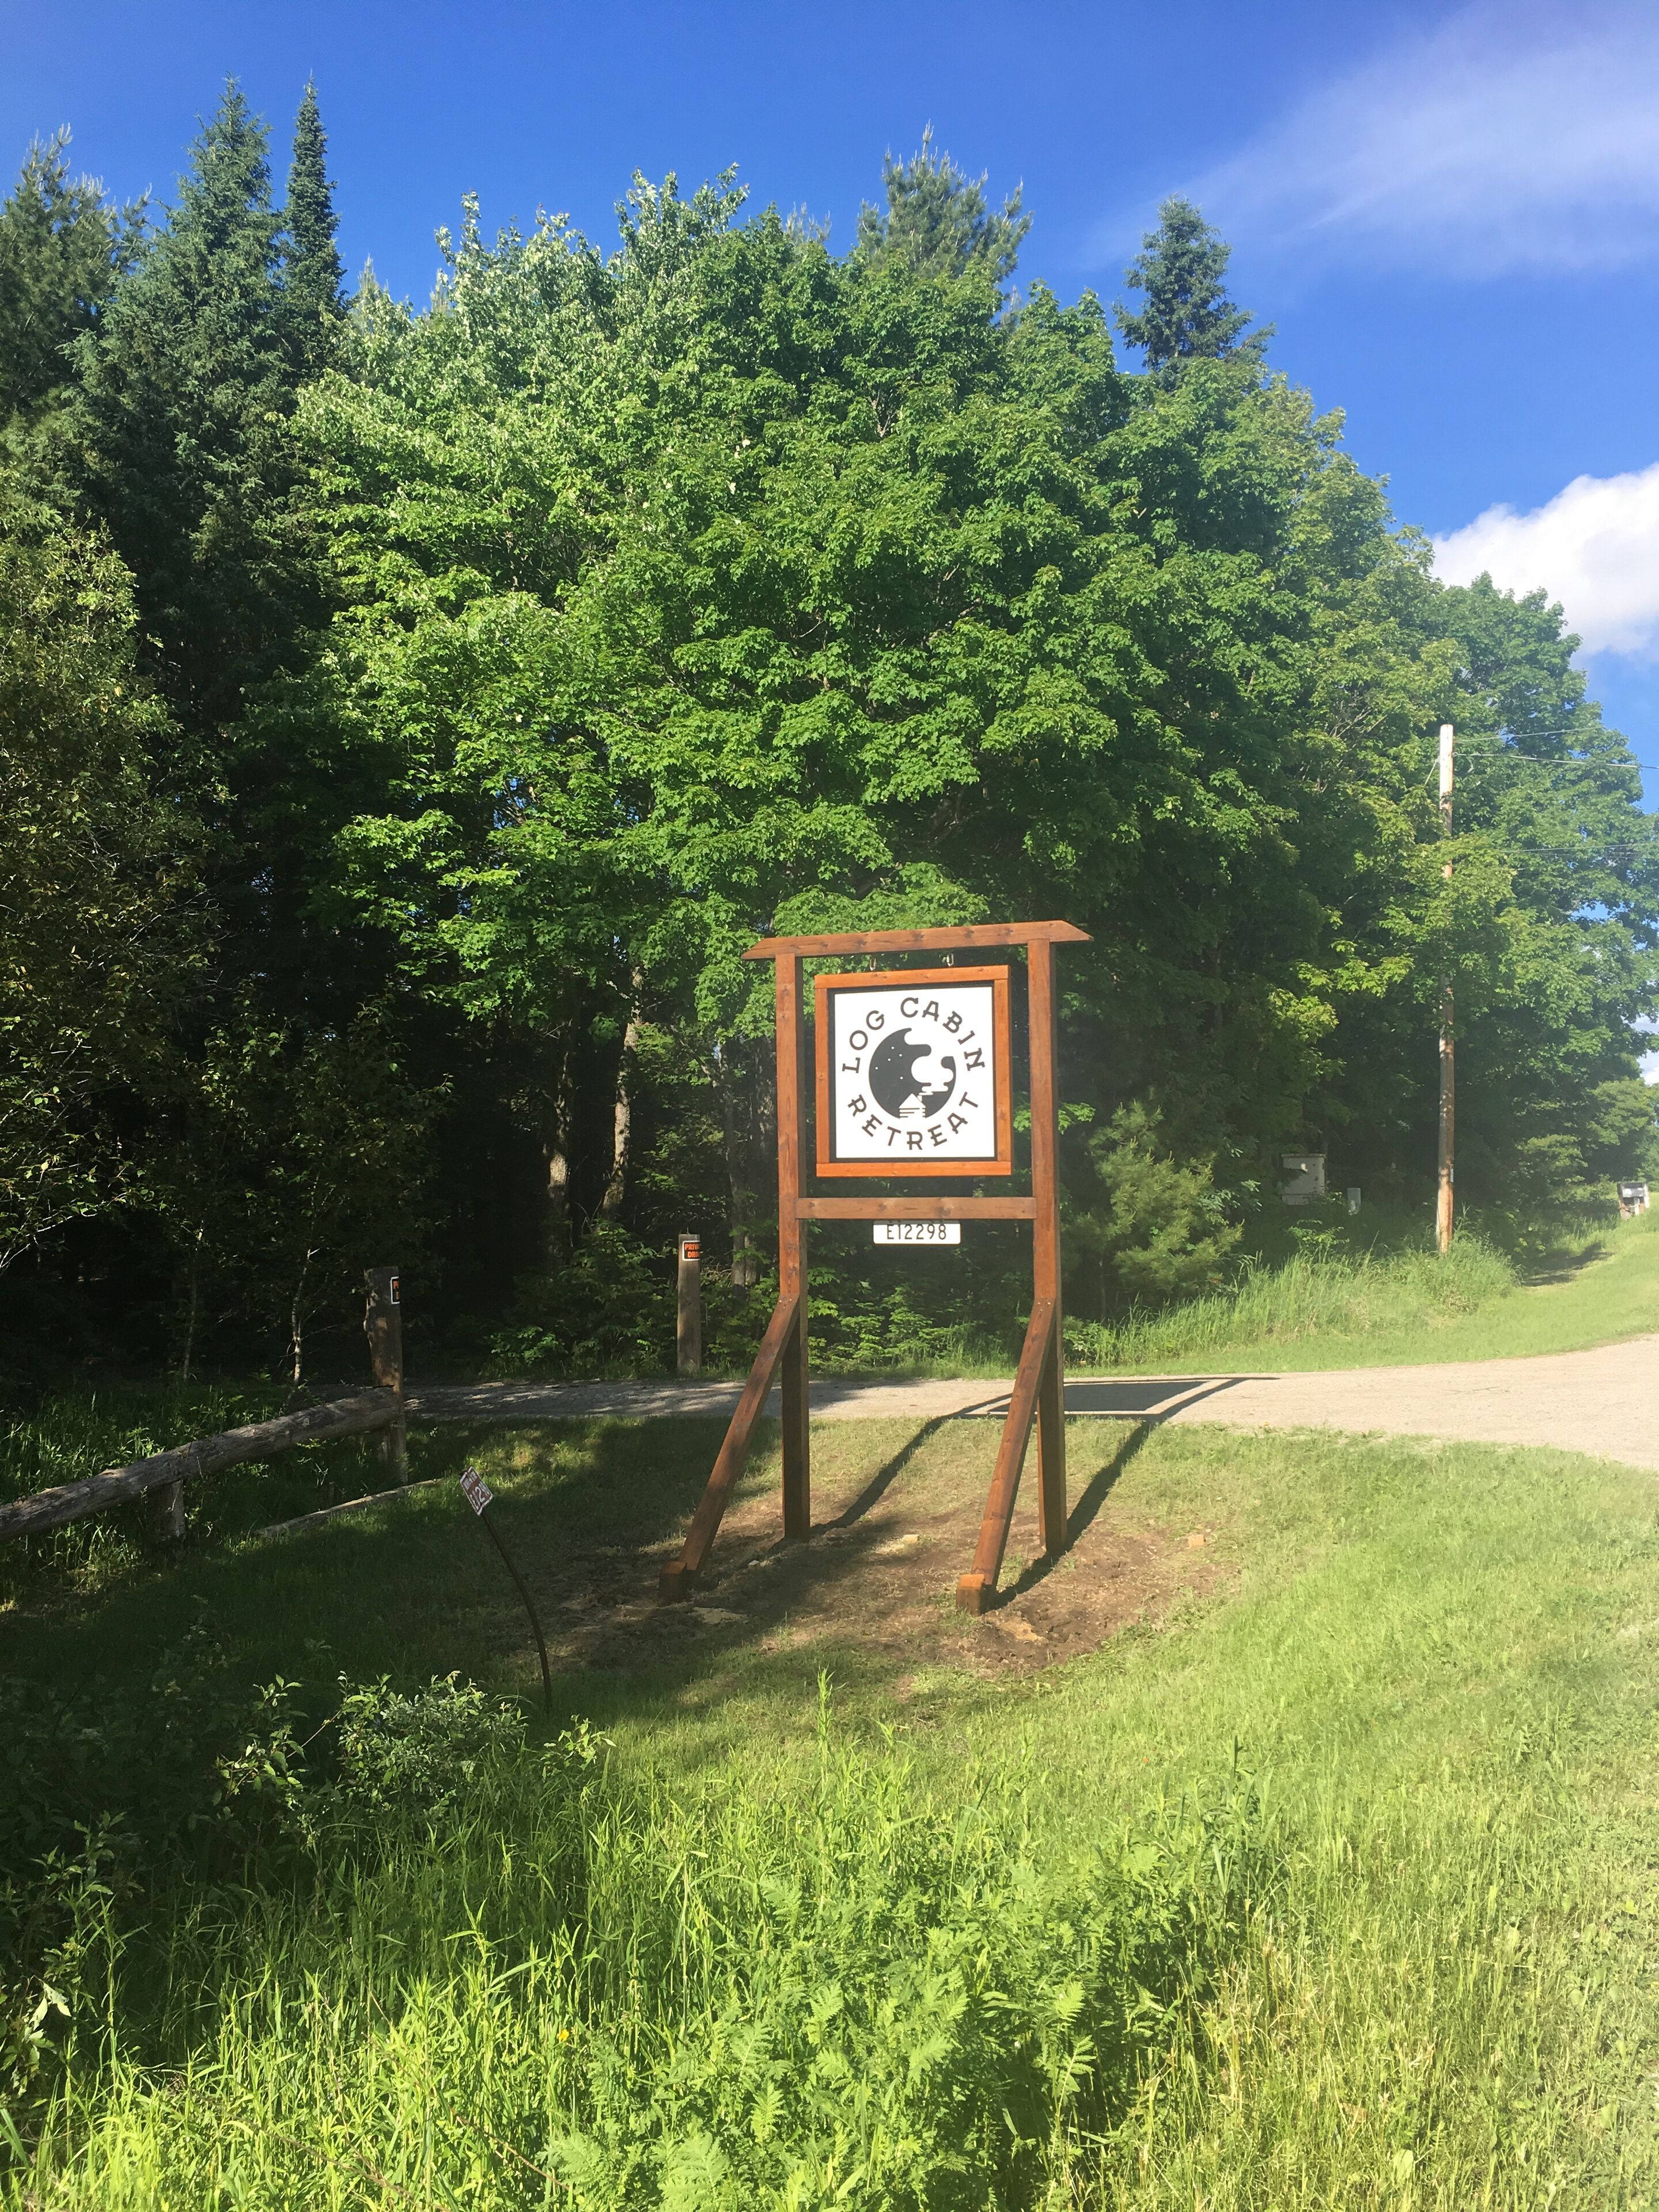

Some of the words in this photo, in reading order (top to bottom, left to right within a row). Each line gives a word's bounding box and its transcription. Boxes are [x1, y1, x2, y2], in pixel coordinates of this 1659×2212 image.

[842, 1010, 884, 1074] LOG
[900, 997, 986, 1071] CABIN
[847, 1092, 979, 1150] RETREAT
[887, 1224, 946, 1240] E12298
